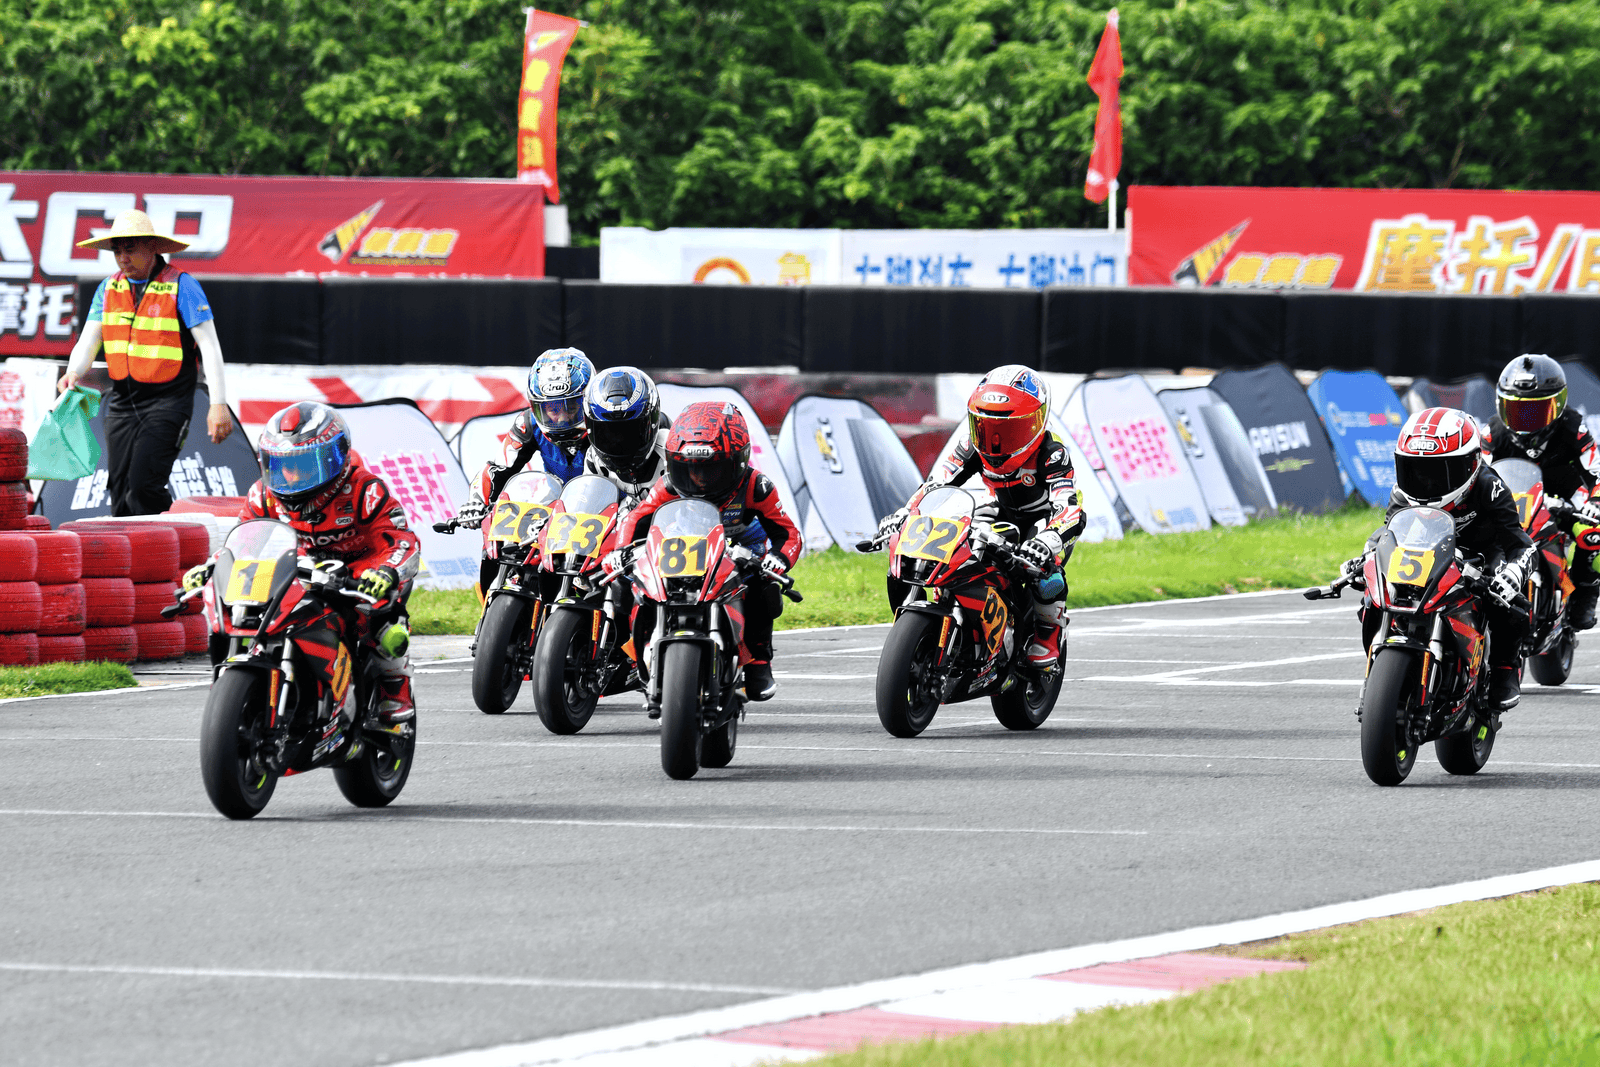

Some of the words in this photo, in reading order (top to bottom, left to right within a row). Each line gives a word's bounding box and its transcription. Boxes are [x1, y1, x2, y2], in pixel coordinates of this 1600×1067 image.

[545, 382, 566, 393] Arai
[686, 448, 710, 457] SHOEI
[1410, 439, 1435, 451] SHOEI
[546, 514, 605, 557] 33
[901, 515, 959, 560] 92
[660, 537, 708, 575] 81
[1396, 550, 1424, 581] 5
[237, 562, 260, 597] 1
